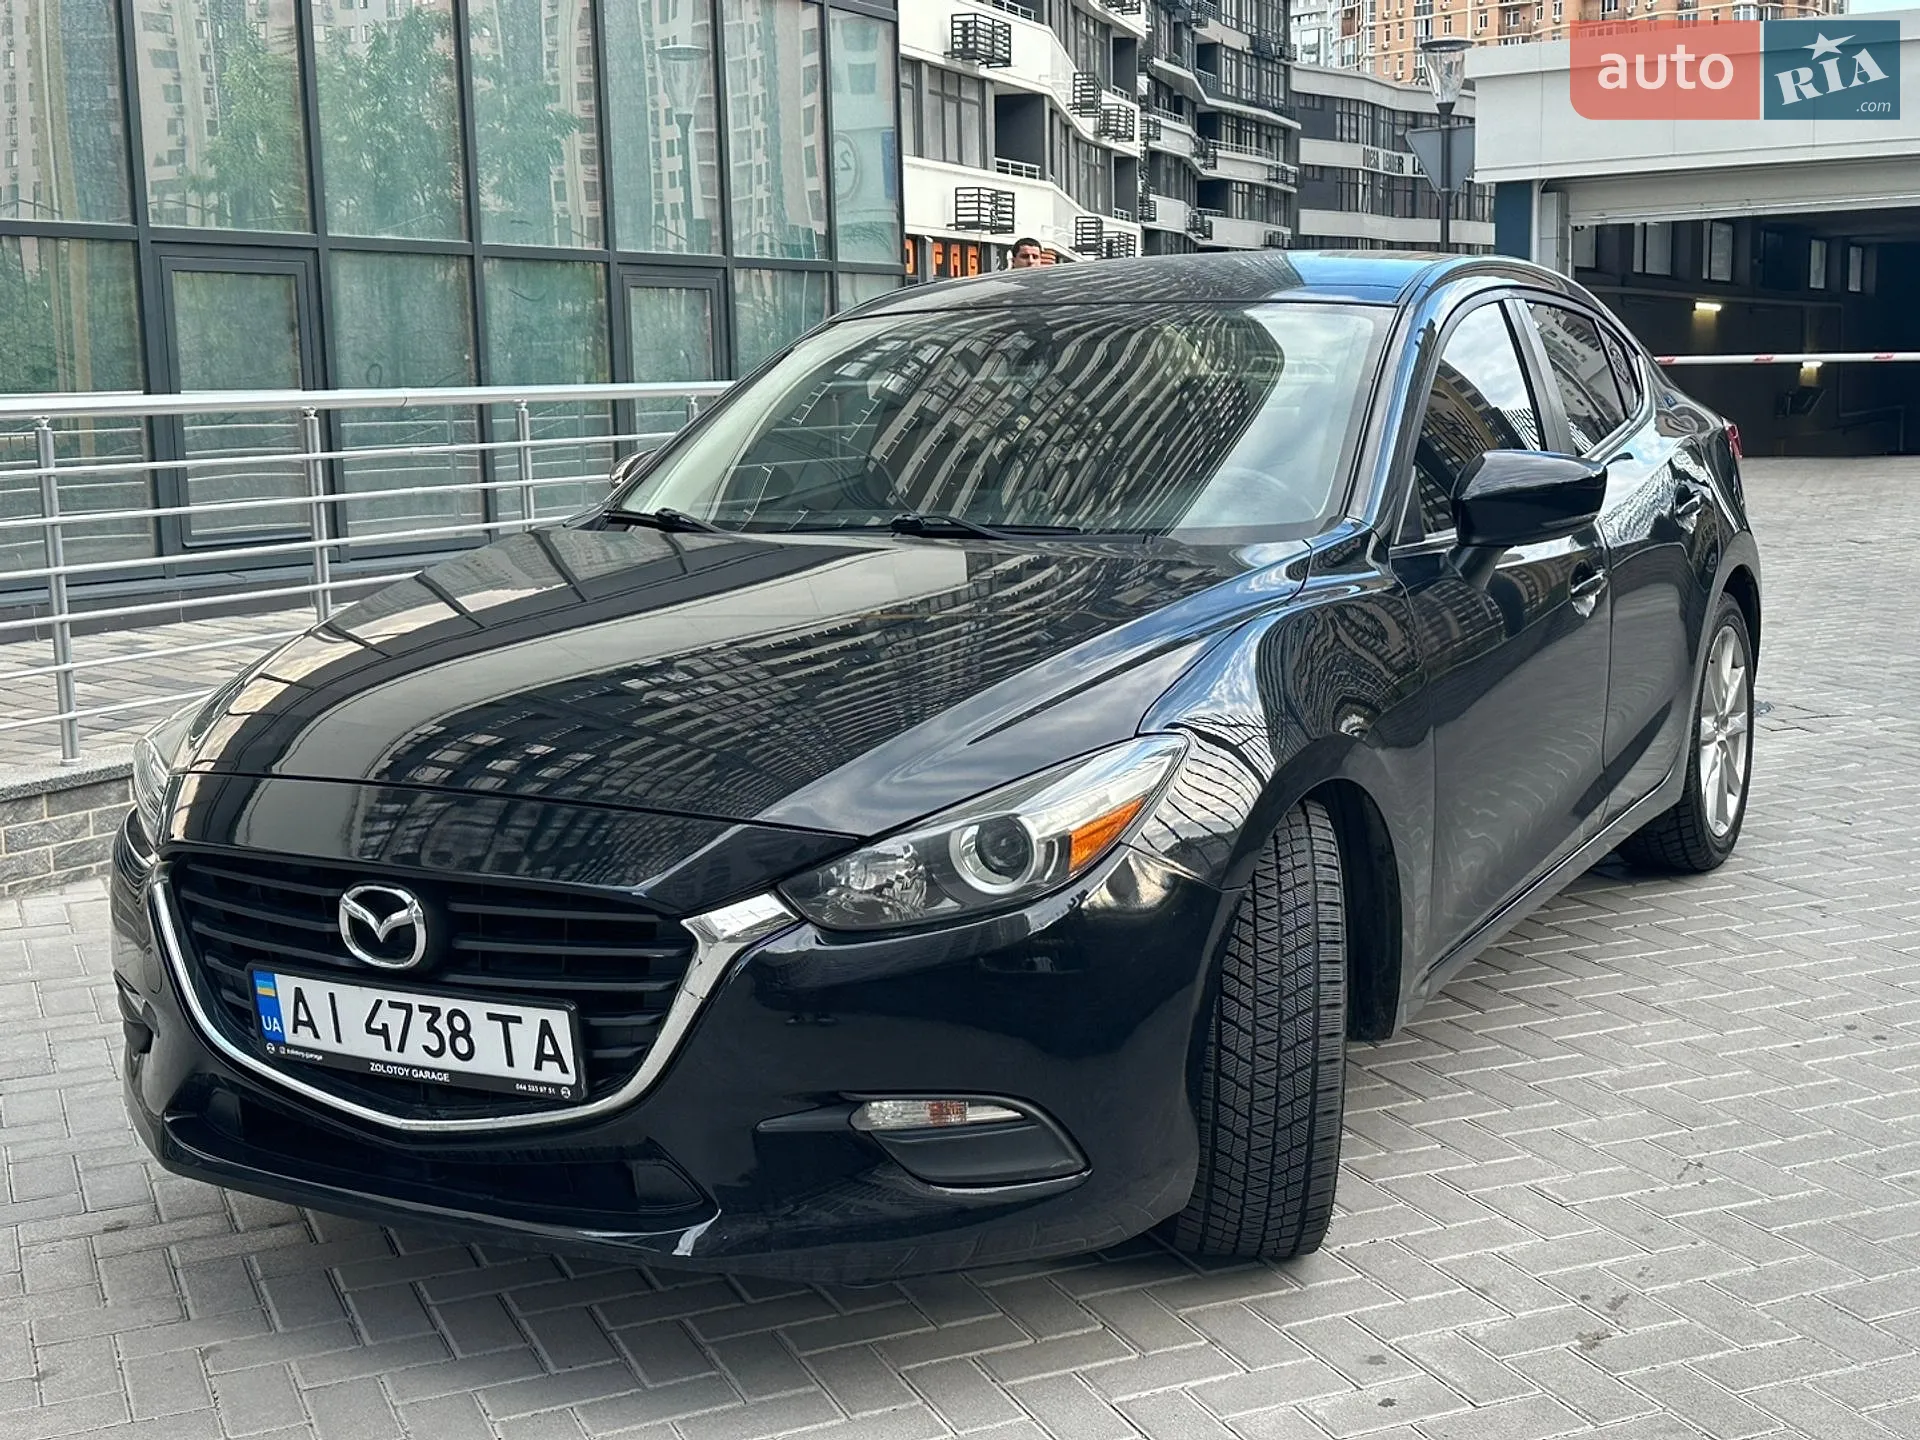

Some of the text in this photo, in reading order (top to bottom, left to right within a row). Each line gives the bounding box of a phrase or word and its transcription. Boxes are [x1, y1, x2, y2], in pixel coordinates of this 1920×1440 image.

[261, 1014, 283, 1033] UA
[291, 986, 570, 1075] AI 4738 TA
[369, 1062, 450, 1083] ZOLOTOY GARAGE
